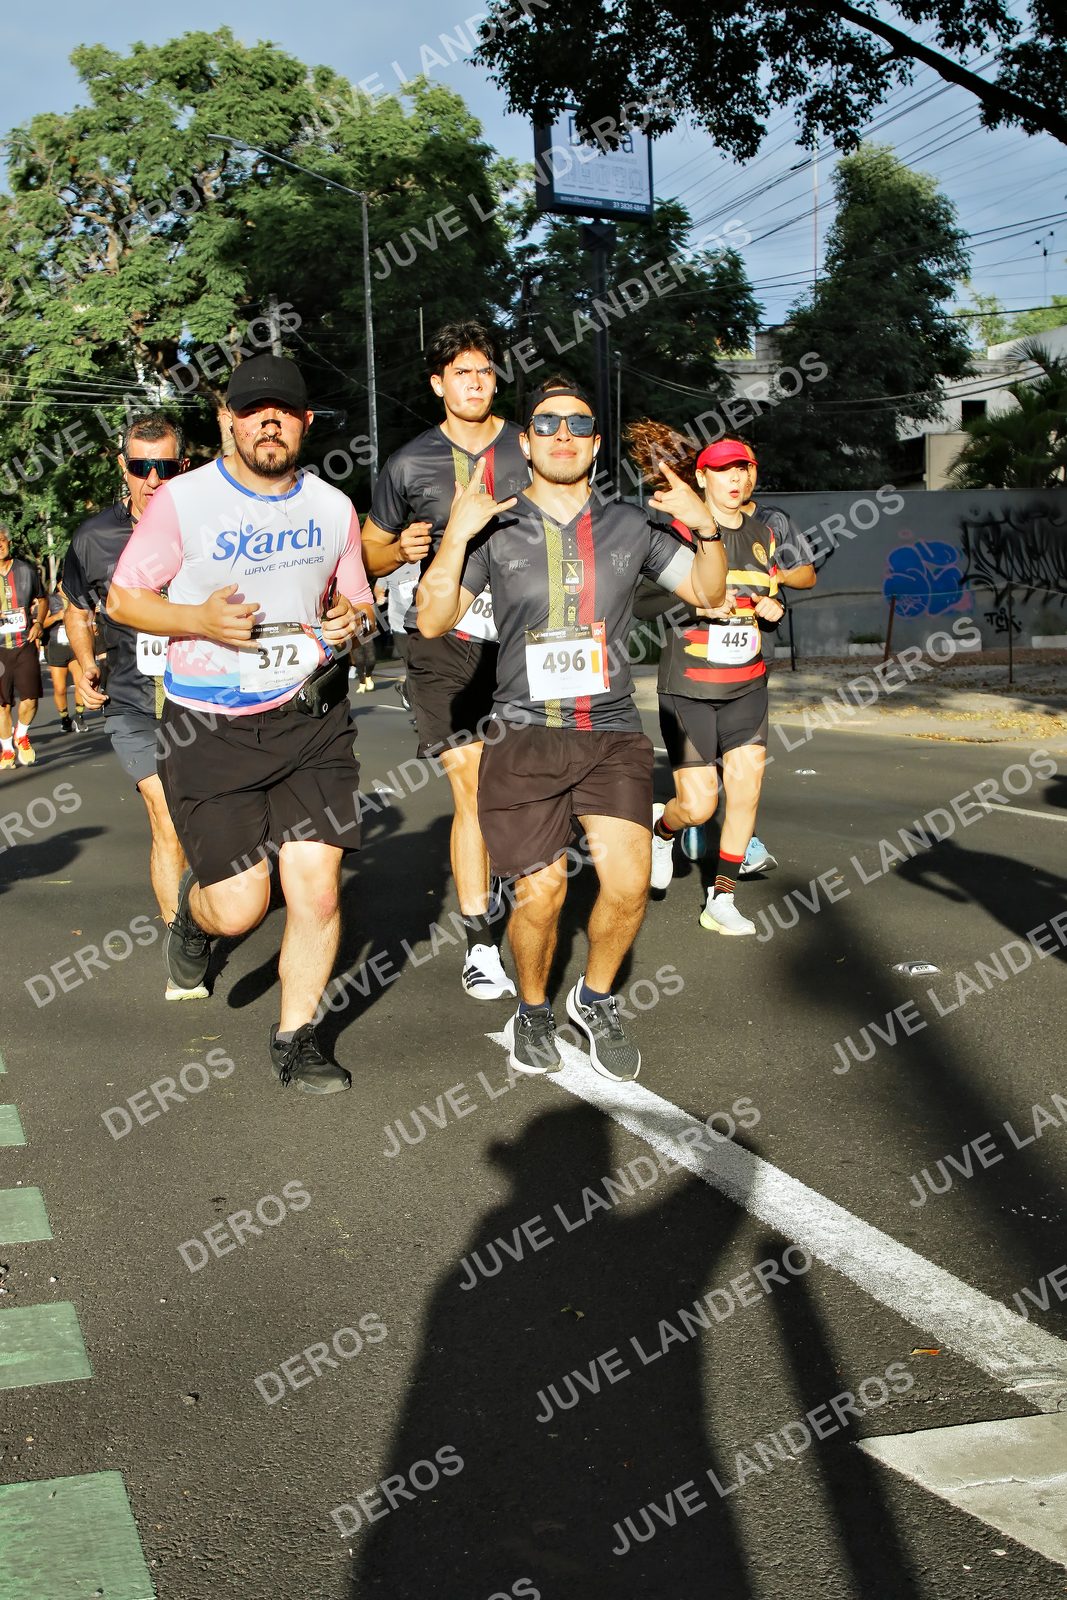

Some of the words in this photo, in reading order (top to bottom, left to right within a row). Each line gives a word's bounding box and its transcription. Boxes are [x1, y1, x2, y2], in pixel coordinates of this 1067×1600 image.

[244, 563, 276, 576] WAVE
[278, 555, 325, 569] RUNNERS
[721, 632, 748, 647] 445
[257, 643, 300, 669] 372
[542, 649, 586, 673] 496
